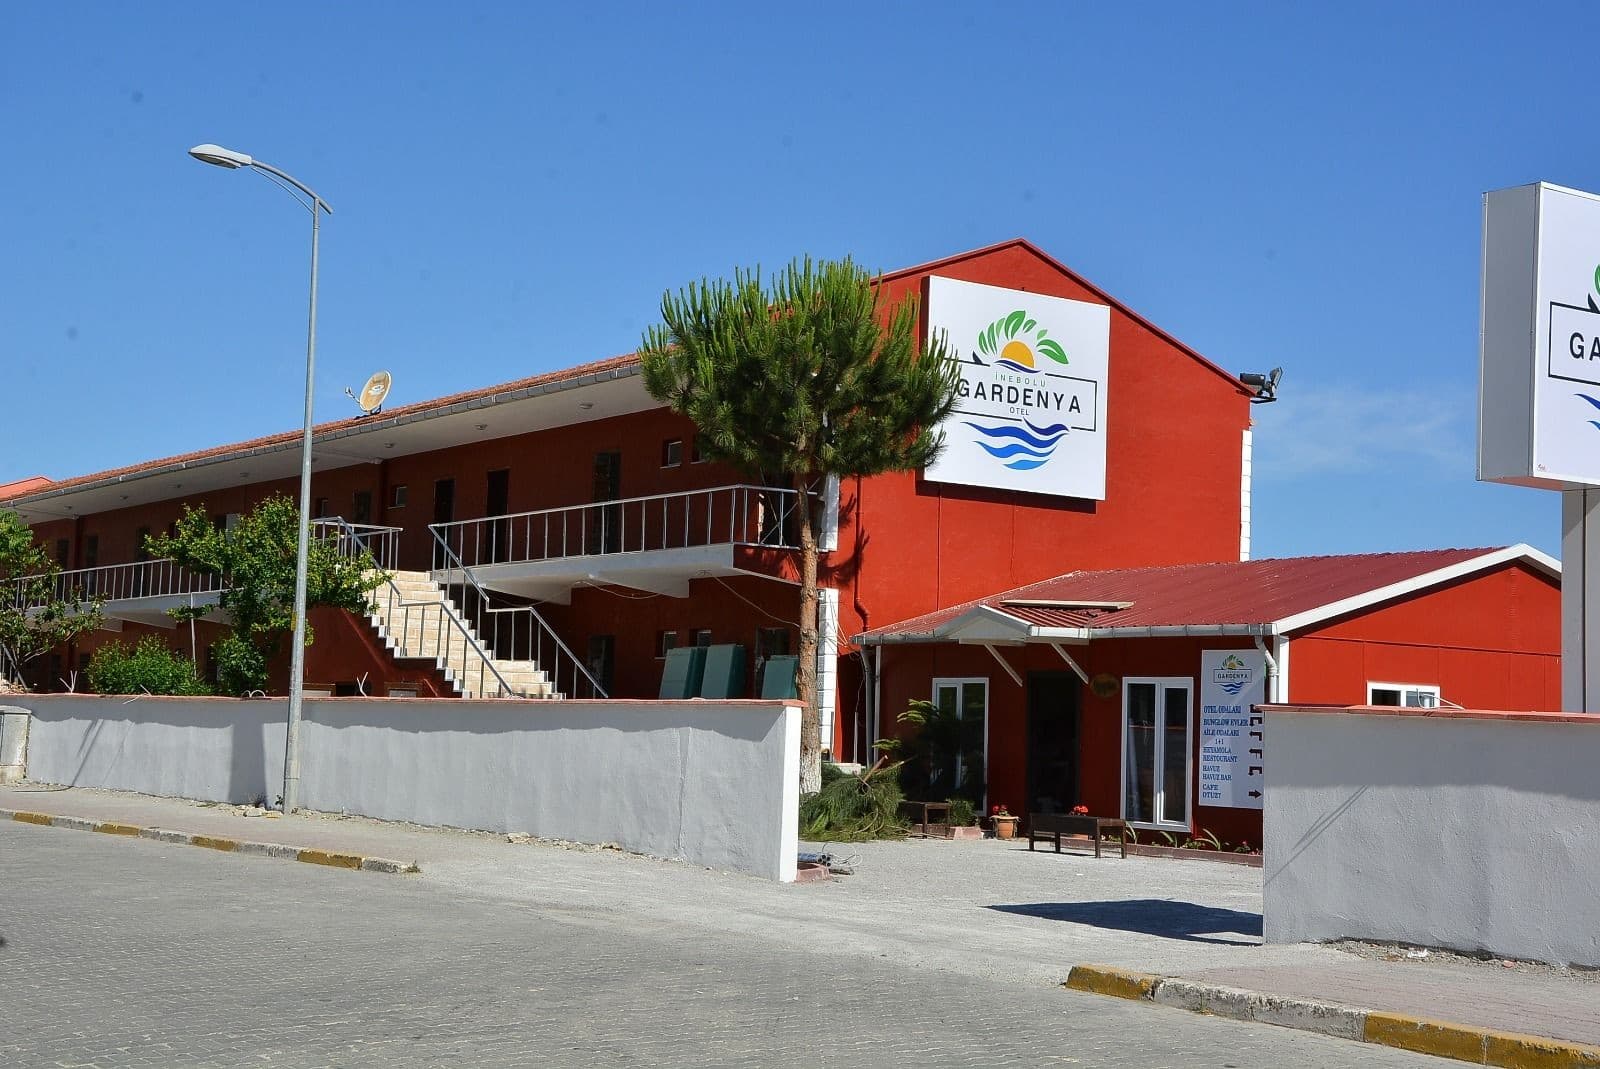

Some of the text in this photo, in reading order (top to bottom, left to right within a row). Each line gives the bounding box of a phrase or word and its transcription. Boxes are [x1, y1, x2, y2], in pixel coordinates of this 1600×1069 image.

[957, 378, 1081, 414] GARDENYA
[1009, 406, 1030, 416] OTEL
[1203, 705, 1217, 714] OTEL
[1202, 783, 1219, 791] CAFE
